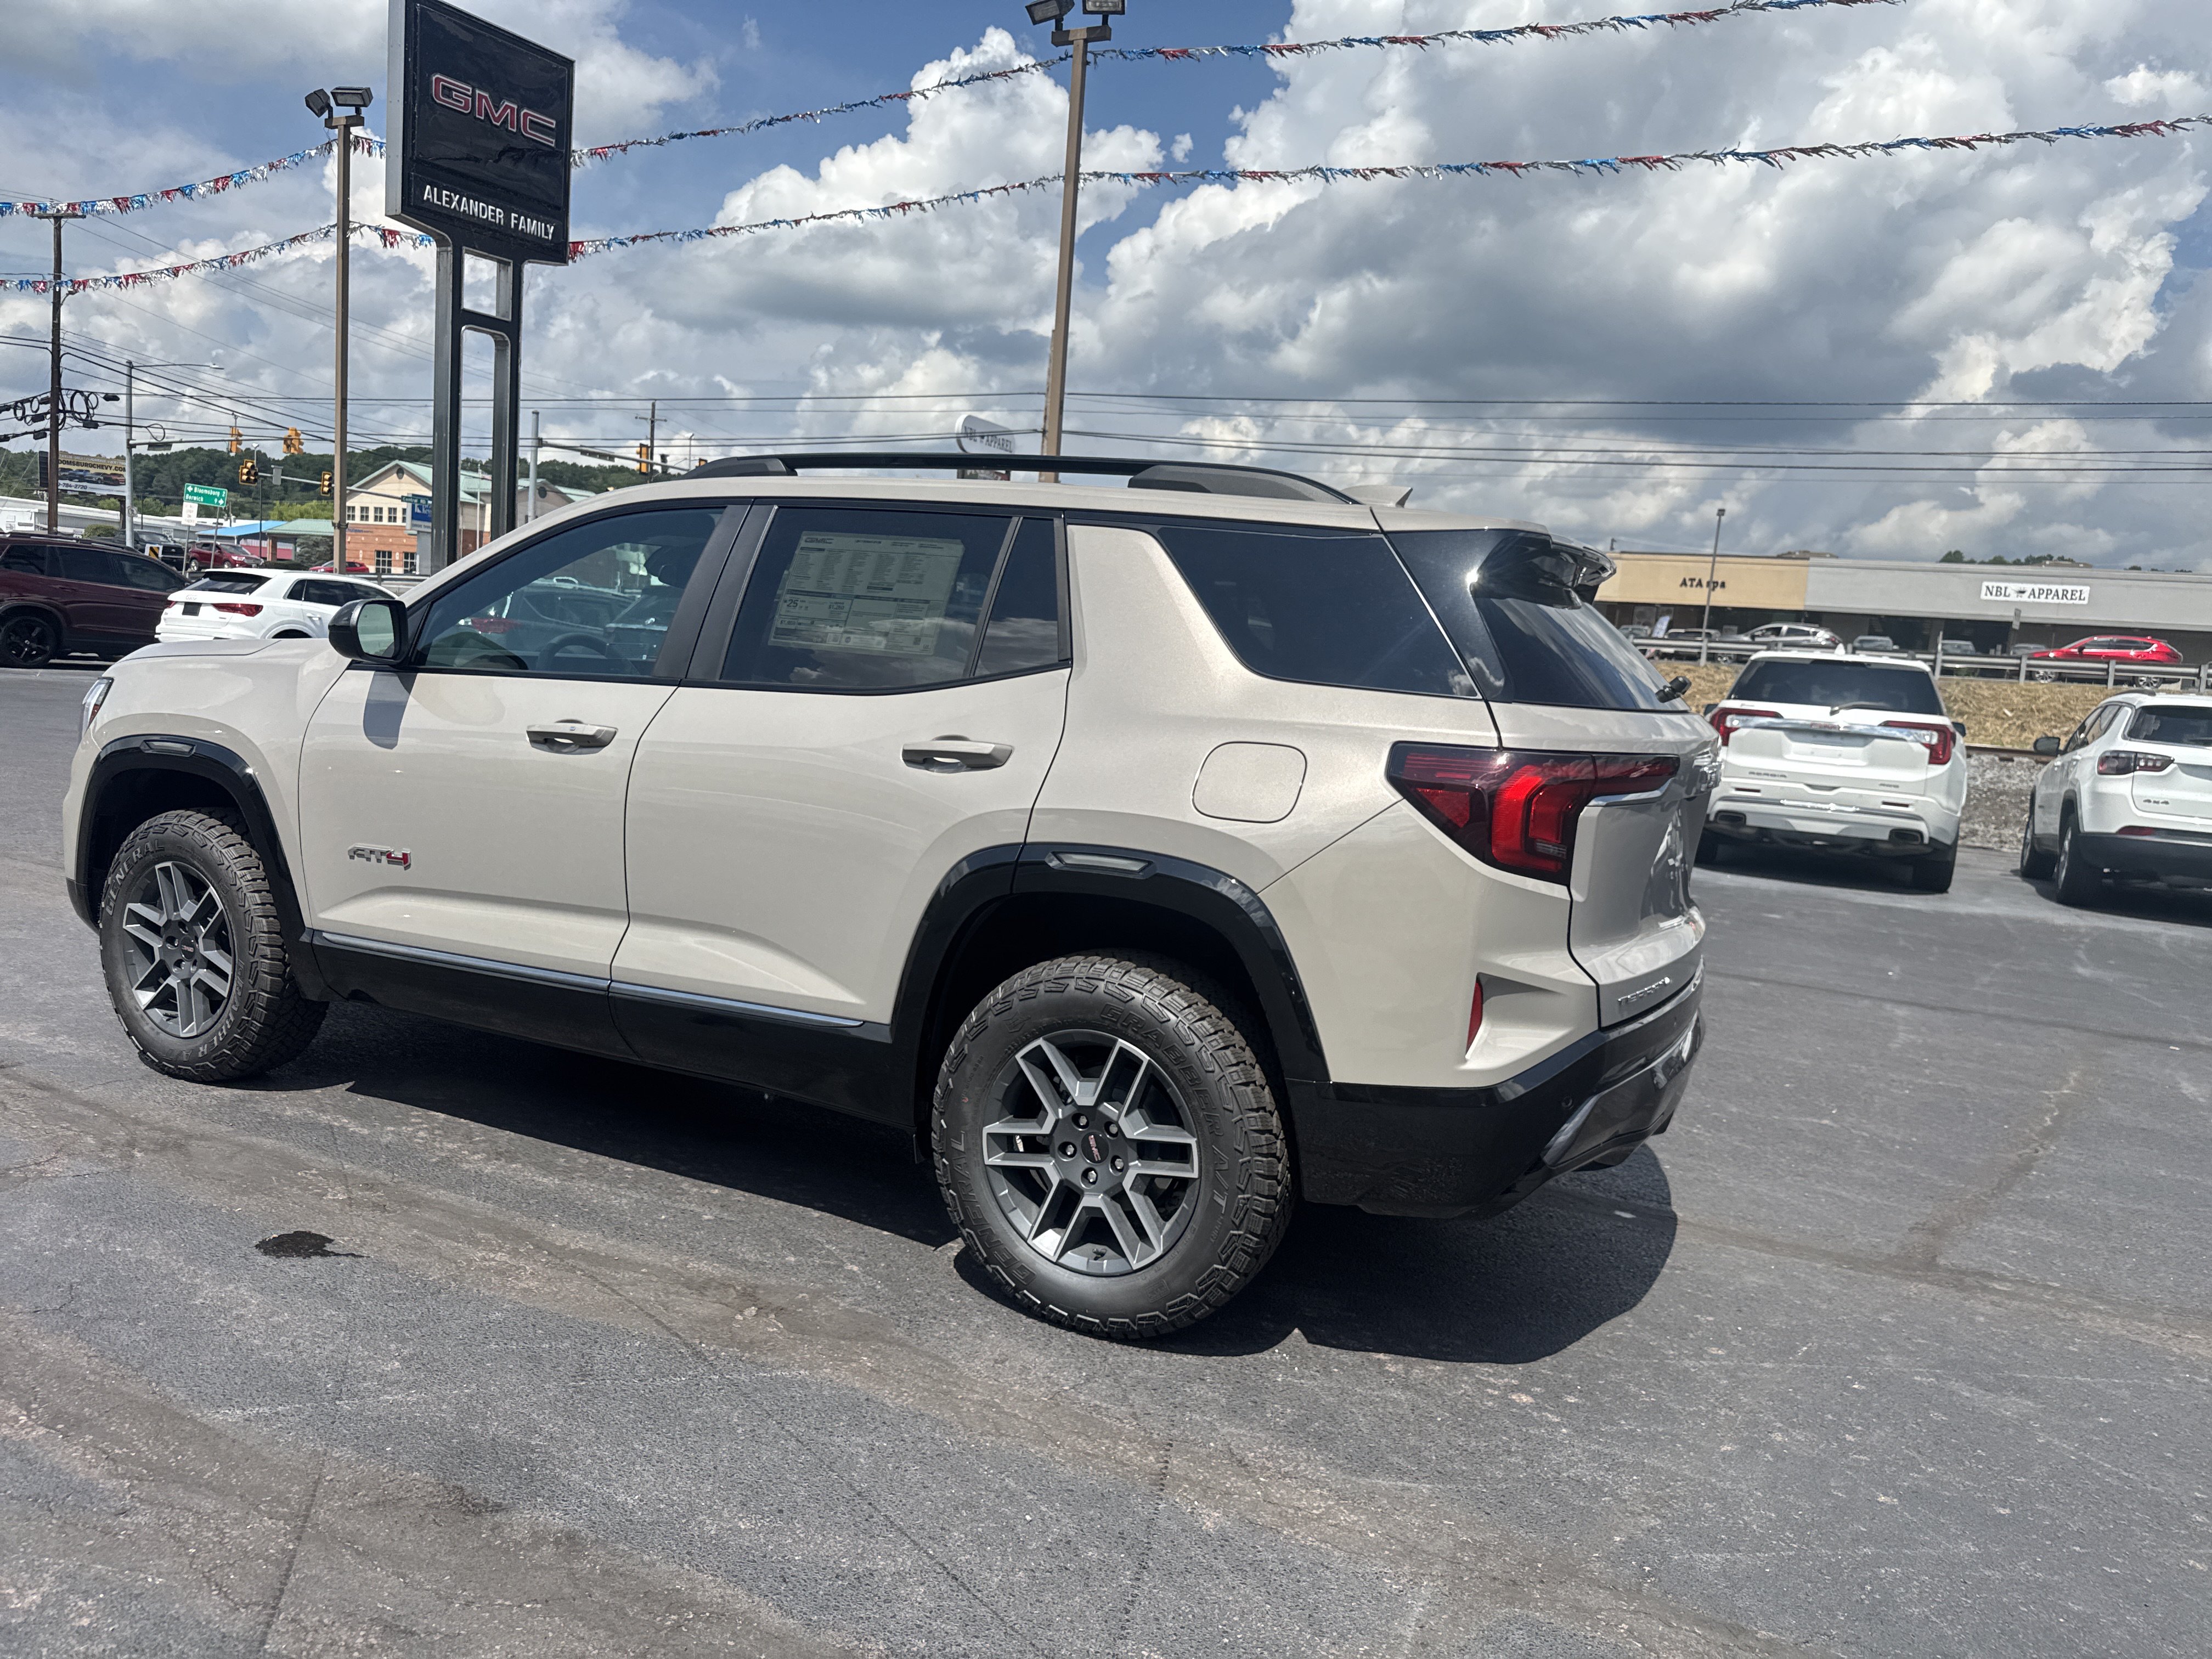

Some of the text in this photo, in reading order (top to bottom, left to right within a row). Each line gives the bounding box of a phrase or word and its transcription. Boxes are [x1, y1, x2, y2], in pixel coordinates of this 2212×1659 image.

[432, 73, 556, 148] GMC
[424, 185, 555, 240] ALEXANDER FAMILY
[194, 487, 220, 496] Bloomsburg
[1679, 577, 1703, 588] ATA
[1984, 585, 2086, 601] NBL APPAREL
[105, 838, 165, 916] GENERAL
[348, 843, 411, 871] AT4
[1099, 1003, 1224, 1136] GRABBER
[950, 1130, 1037, 1285] GENERAL
